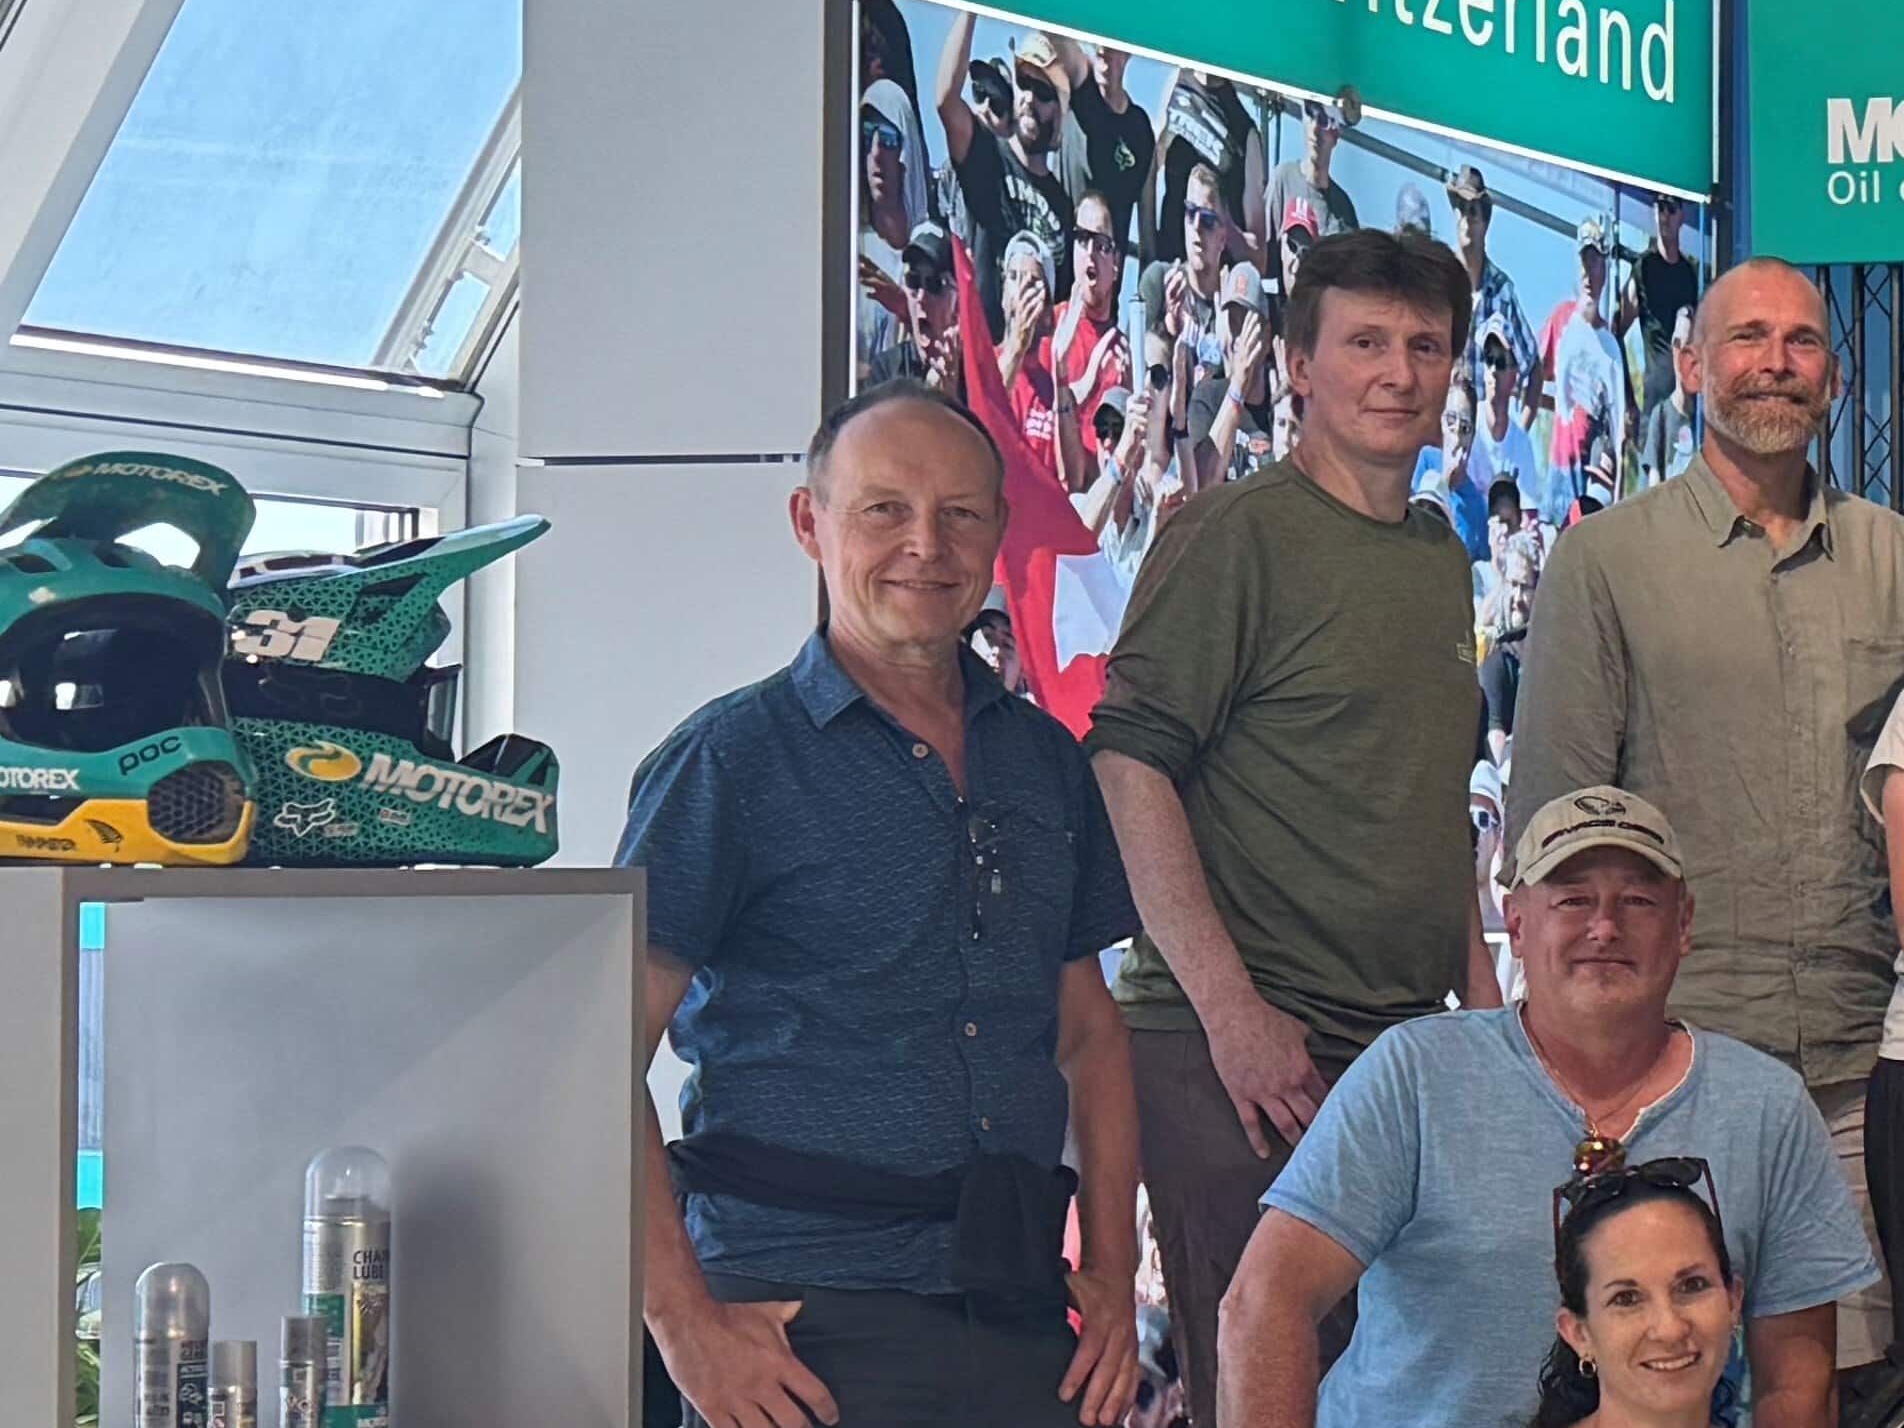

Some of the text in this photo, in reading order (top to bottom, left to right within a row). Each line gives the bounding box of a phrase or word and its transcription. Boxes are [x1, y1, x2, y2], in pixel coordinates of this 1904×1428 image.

[1827, 170, 1880, 205] Oil
[93, 462, 228, 497] MOTOREX
[234, 610, 342, 662] 31
[0, 767, 80, 790] OTOREX
[359, 752, 556, 834] MOTOREX
